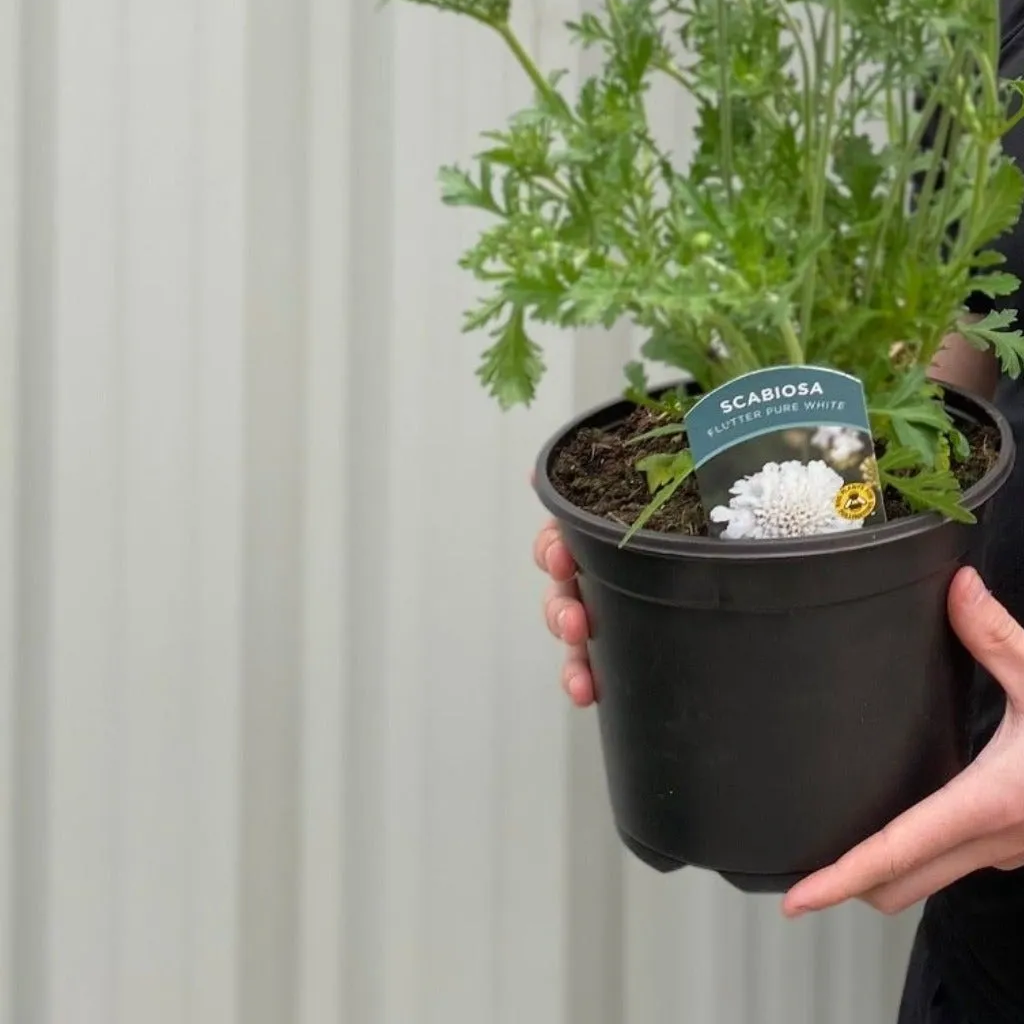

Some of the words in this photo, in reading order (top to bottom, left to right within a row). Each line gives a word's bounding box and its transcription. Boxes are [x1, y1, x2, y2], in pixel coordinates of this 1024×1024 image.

[719, 381, 824, 414] SCABIOSA
[706, 409, 762, 438] FLUTTER
[765, 401, 799, 416] PURE
[803, 400, 847, 411] WHITE
